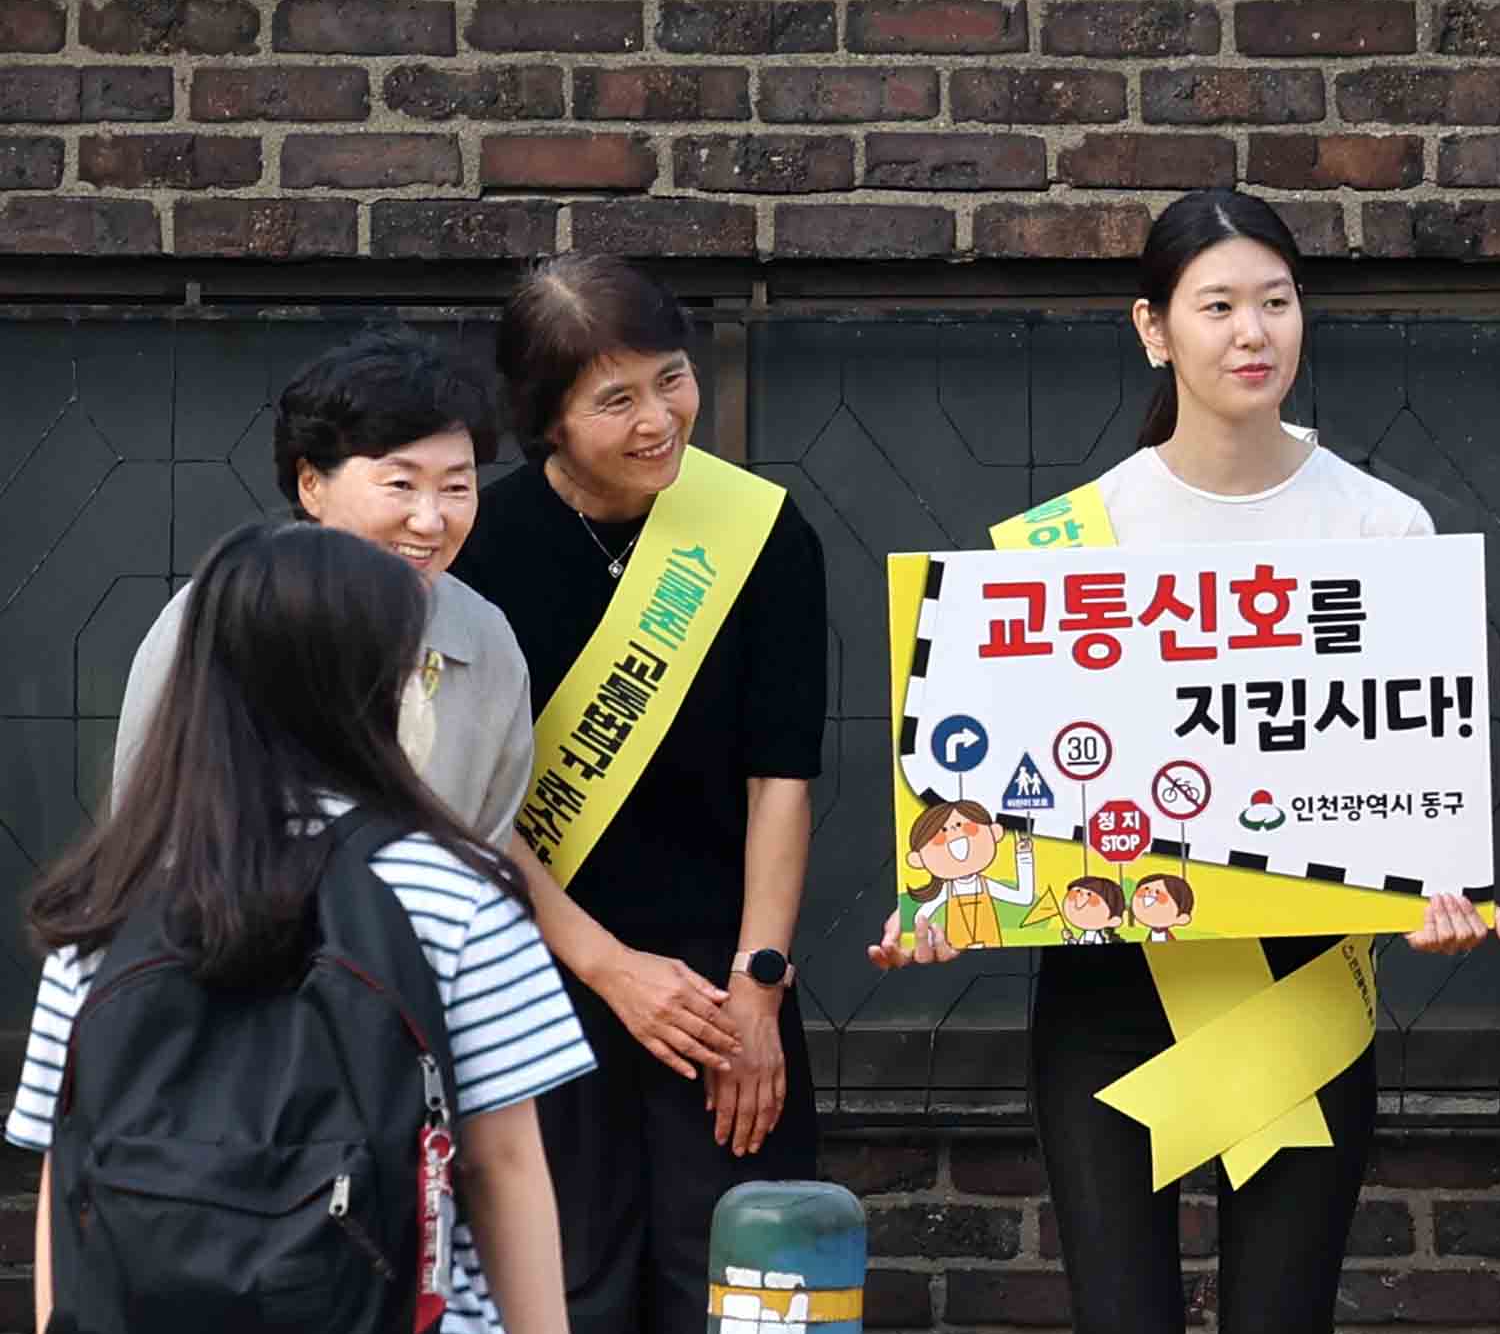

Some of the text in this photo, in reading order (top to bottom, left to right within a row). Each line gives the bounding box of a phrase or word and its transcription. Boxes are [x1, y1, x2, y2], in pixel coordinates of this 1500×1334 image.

[978, 563, 1368, 671] 교통신호를
[1174, 675, 1475, 753] 지킵시다!
[1066, 736, 1098, 761] 30
[1291, 791, 1464, 825] 인천광역시 동구
[1101, 834, 1141, 853] STOP
